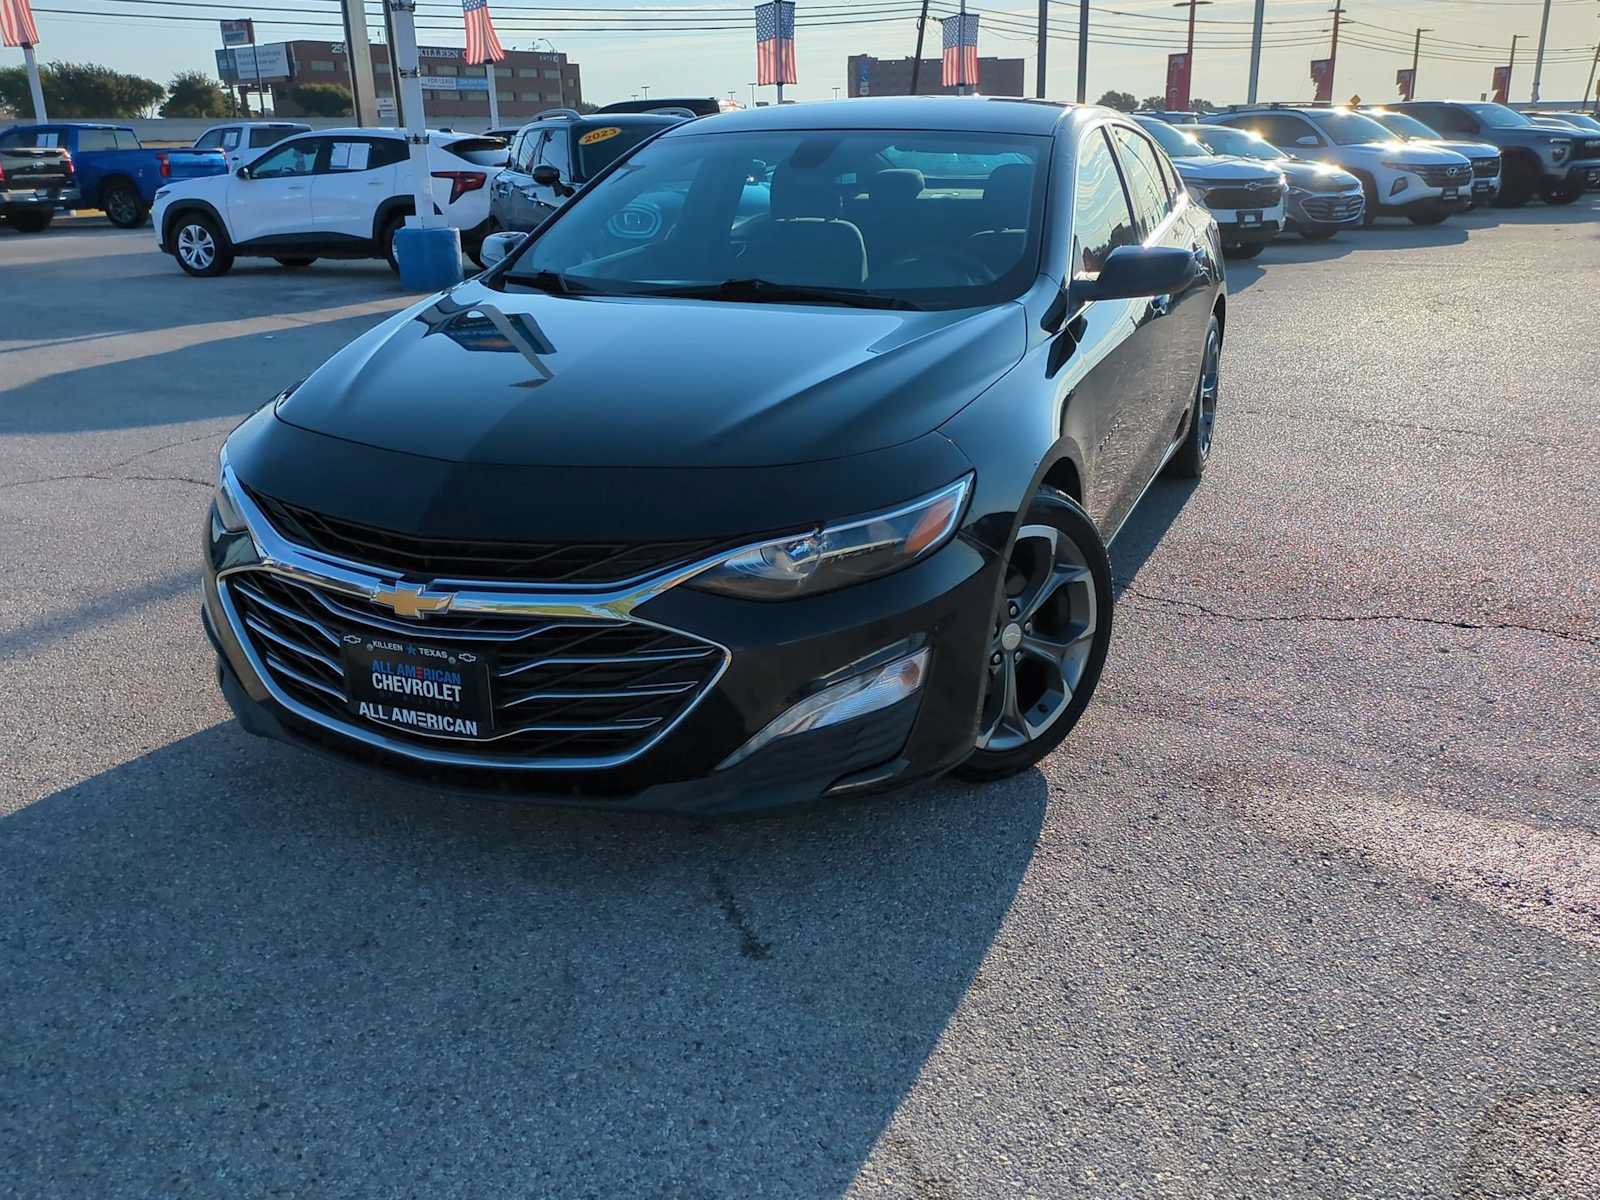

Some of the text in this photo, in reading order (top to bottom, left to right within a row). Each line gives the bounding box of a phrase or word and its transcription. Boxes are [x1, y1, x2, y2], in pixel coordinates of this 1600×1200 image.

[584, 127, 617, 144] 2023
[372, 639, 448, 659] KILLEEN TEXAS
[372, 660, 462, 685] ALL AMERICAN
[371, 672, 462, 702] CHEVROLET
[359, 702, 478, 736] ALL AMERICAN
